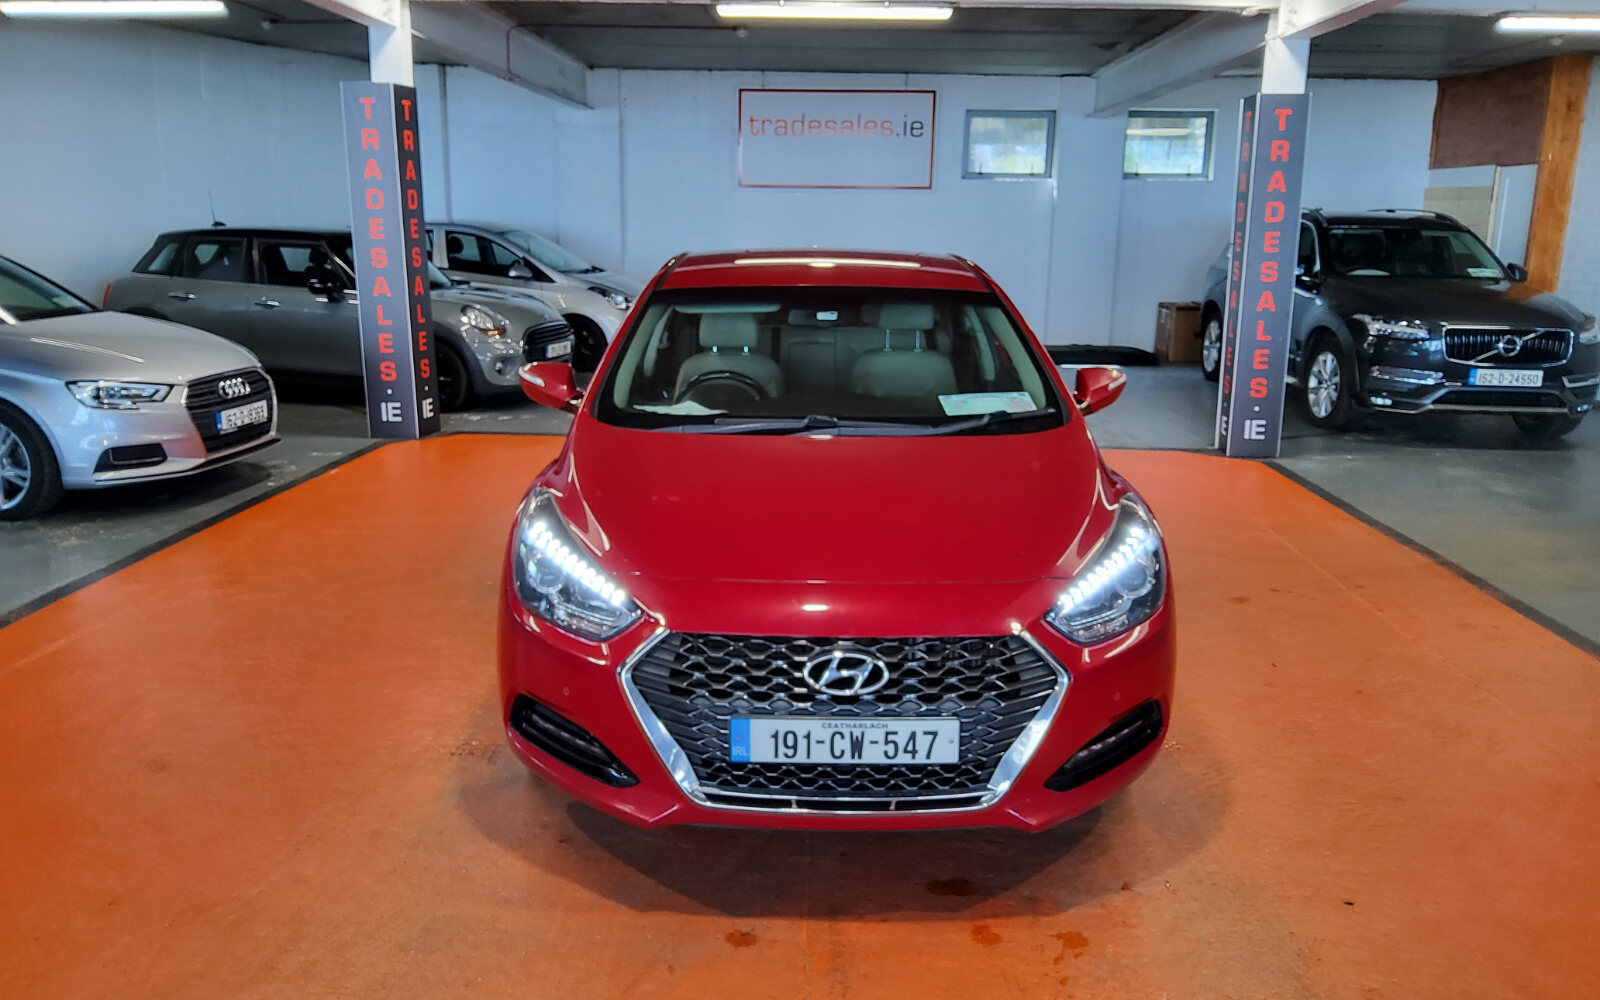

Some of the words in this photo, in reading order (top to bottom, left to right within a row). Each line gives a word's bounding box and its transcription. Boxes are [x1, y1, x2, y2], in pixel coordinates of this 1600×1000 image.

[748, 112, 924, 138] tradesales.ie
[1479, 373, 1539, 385] 152-D-24550
[821, 722, 888, 730] CEATHARLACH
[731, 745, 749, 757] IRL
[769, 729, 938, 761] 191-CW-547
